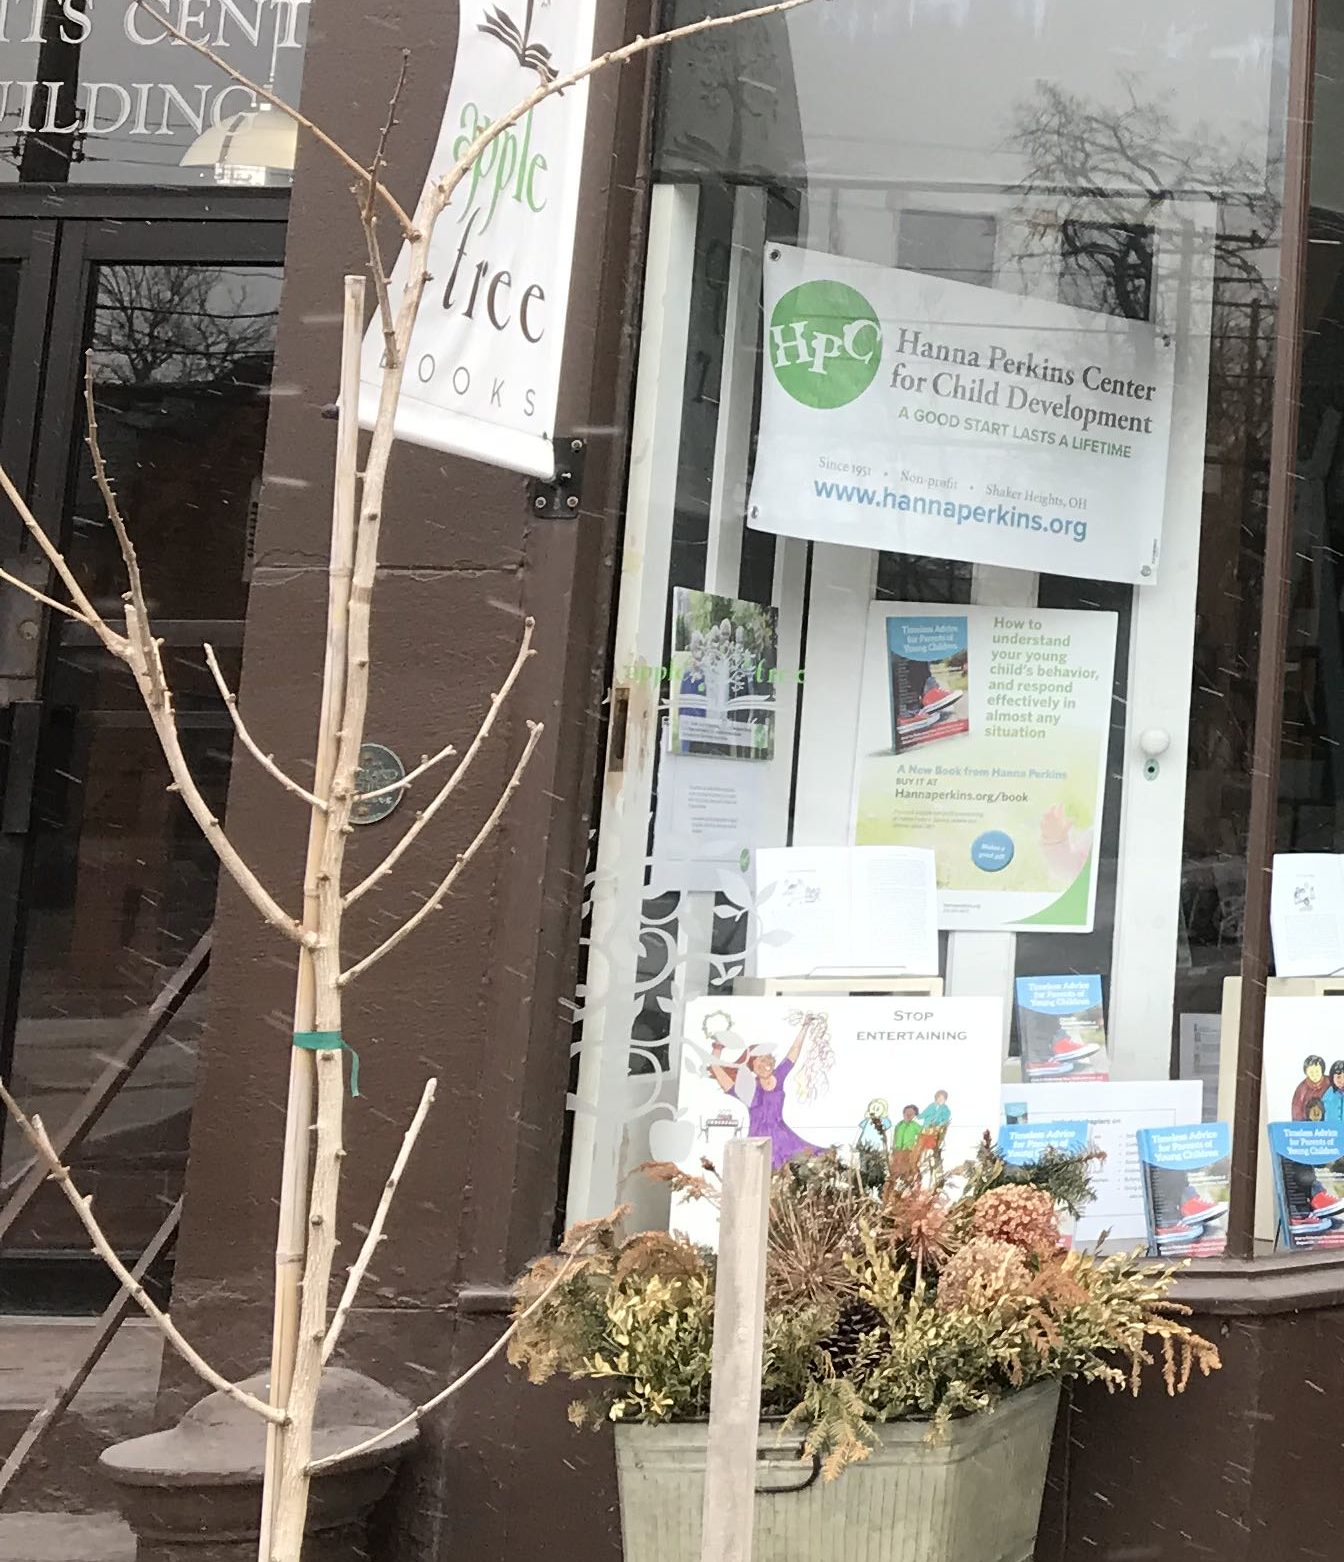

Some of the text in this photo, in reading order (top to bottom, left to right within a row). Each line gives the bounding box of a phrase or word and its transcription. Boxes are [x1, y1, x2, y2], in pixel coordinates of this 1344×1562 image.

[443, 207, 546, 344] tree
[770, 320, 881, 374] HPC
[896, 328, 1157, 402] Hanna Perkins Center
[890, 363, 1153, 434] for Child Development
[898, 407, 1132, 459] A GOOD START LASTS A LIFETIME
[818, 456, 1087, 510] Since 1951 Non-profit Shaker Heights, OH
[813, 480, 1088, 541] www.hannaperkins.org
[993, 617, 1042, 630] How to
[992, 634, 1072, 647] understand
[991, 651, 1068, 664] your young
[989, 664, 1101, 681] child's behavior,
[988, 679, 1073, 695] and respond
[987, 694, 1077, 710] effectively in
[986, 710, 1061, 726] almost any
[984, 726, 1046, 740] situation
[908, 765, 933, 775] New
[935, 766, 961, 776] Book
[964, 766, 989, 777] from
[1028, 769, 1067, 780] Perkins
[896, 778, 914, 786] BUY
[895, 789, 1029, 803] Hannaperkins.org/book
[856, 1031, 968, 1041] ENTERTAINING
[1151, 1131, 1218, 1143] Timeless Advice
[1314, 1129, 1338, 1137] Advice
[1172, 1142, 1203, 1152] Parents
[1310, 1146, 1339, 1155] Children
[1154, 1150, 1219, 1162] Young Children
